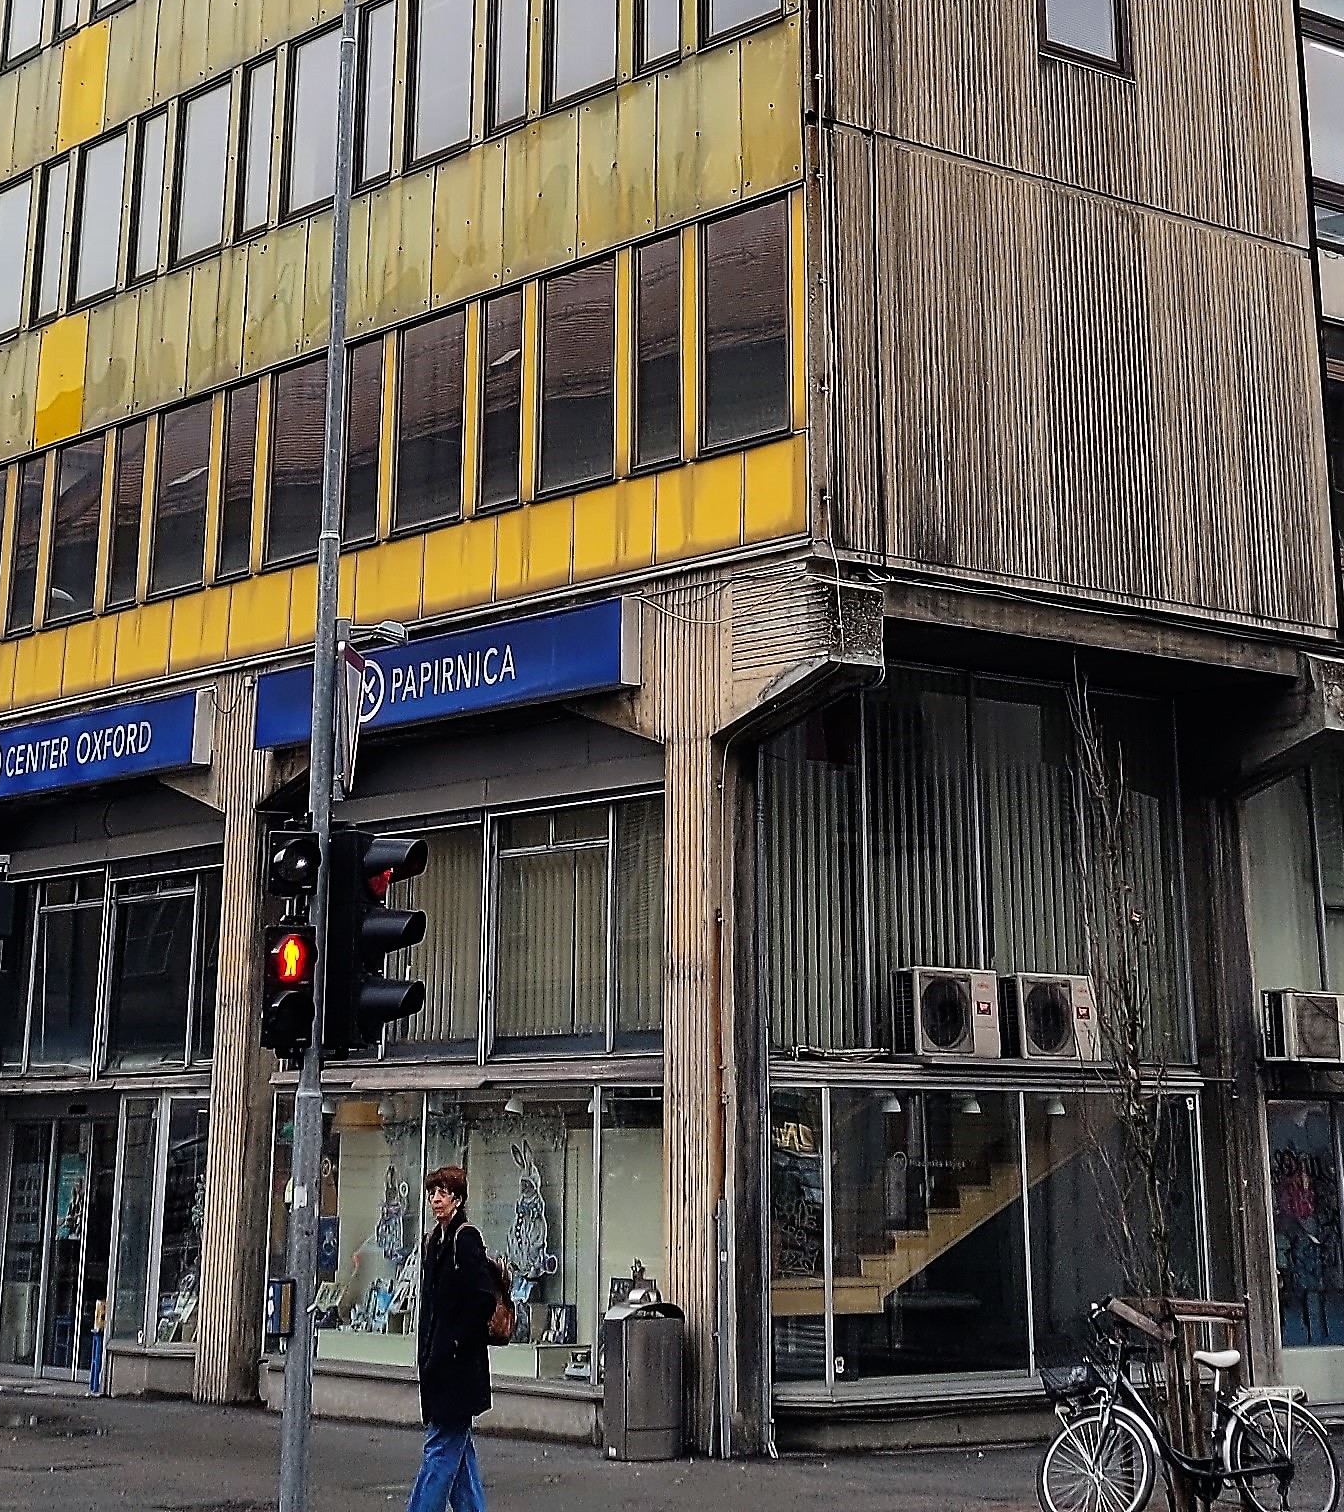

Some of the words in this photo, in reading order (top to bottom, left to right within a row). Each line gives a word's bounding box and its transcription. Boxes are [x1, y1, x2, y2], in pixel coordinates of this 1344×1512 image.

[390, 644, 517, 703] PAPIRNICA
[6, 736, 69, 778] CENTER
[76, 721, 153, 765] OXFORD
